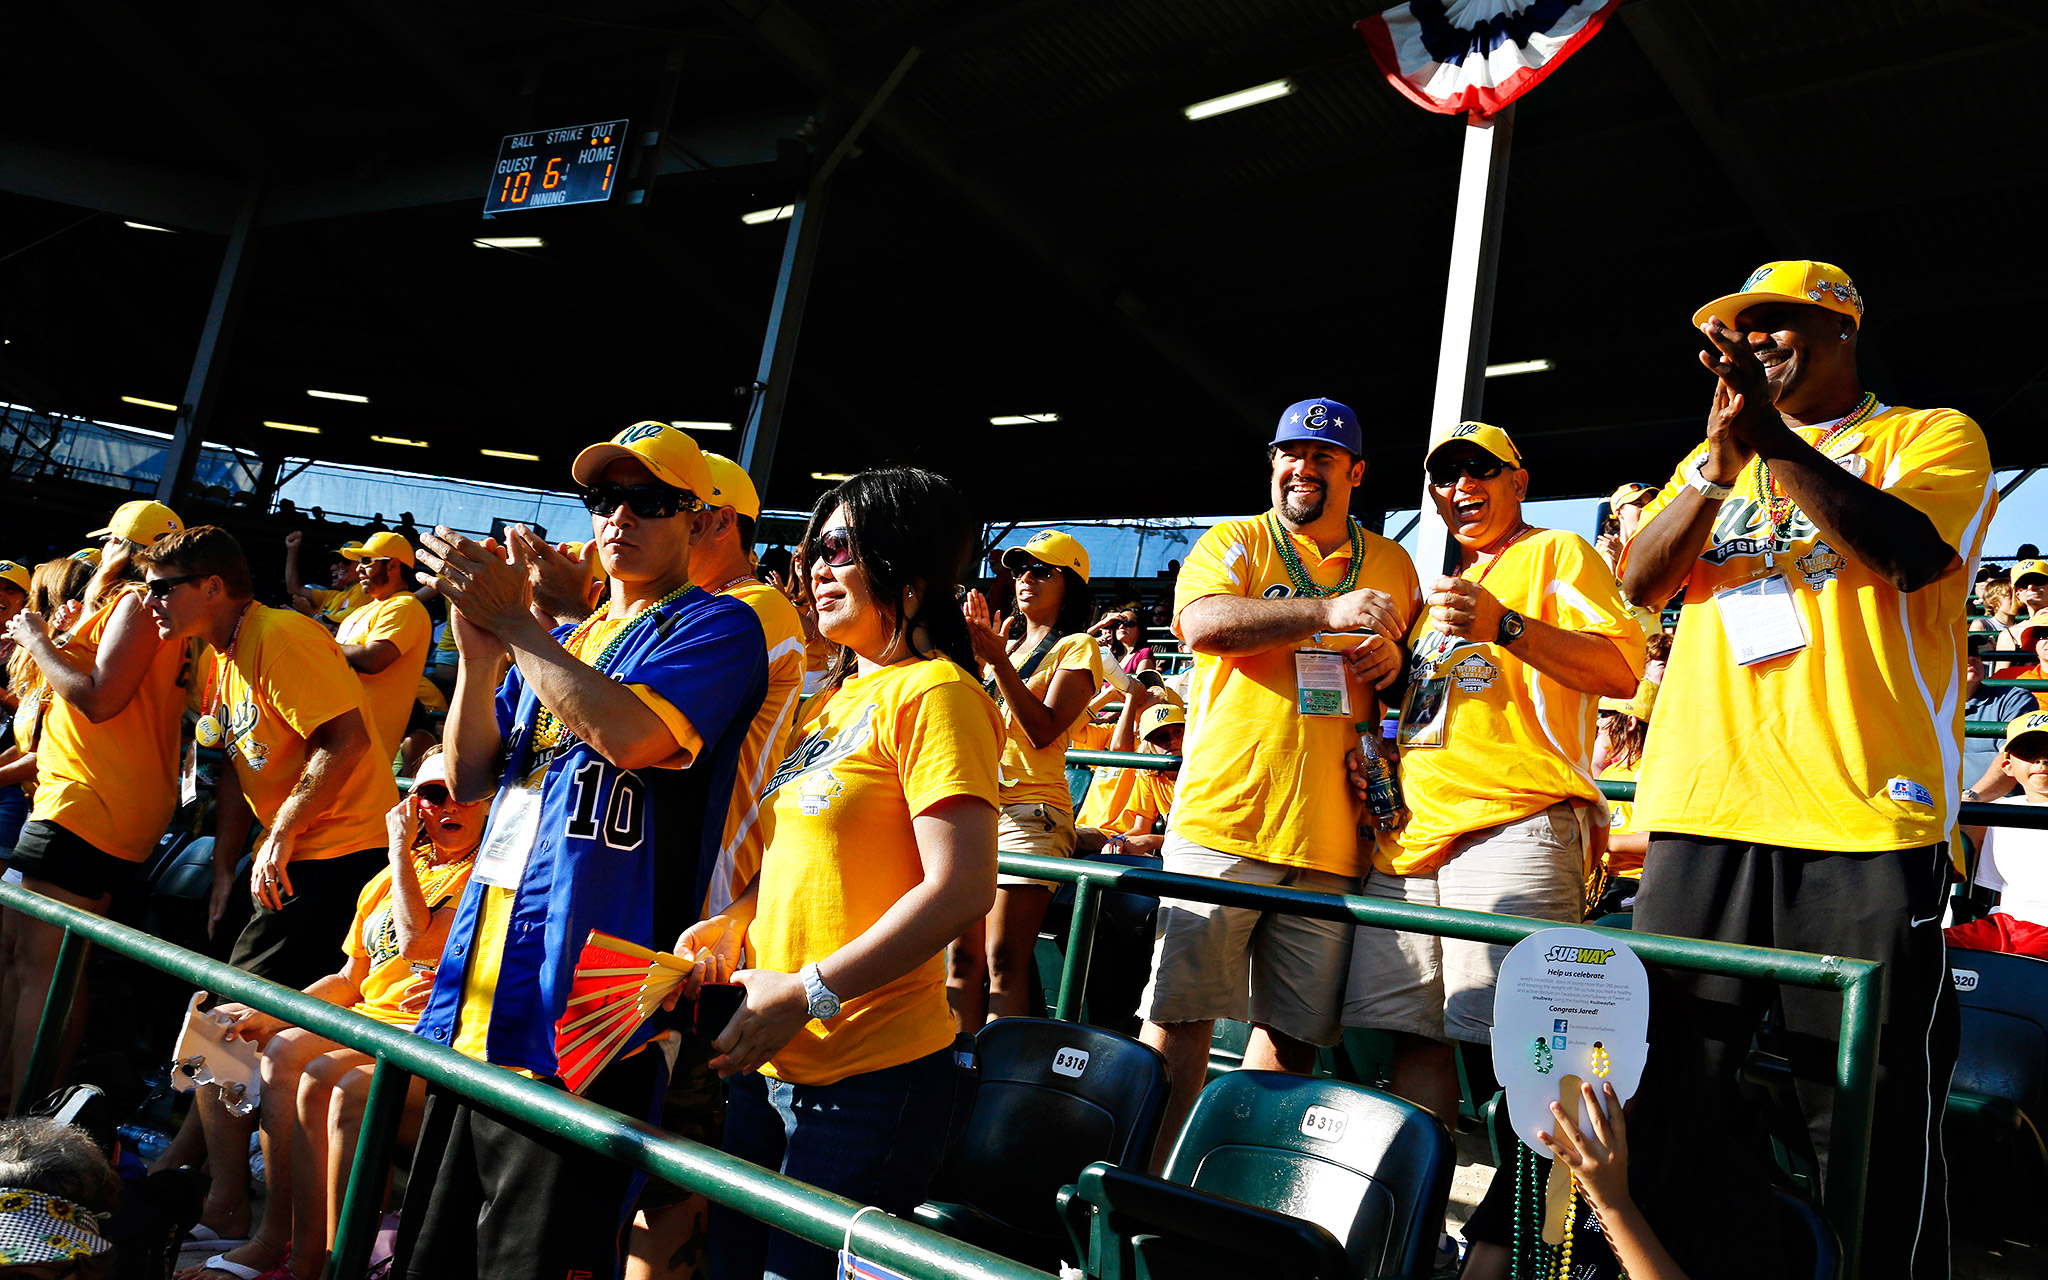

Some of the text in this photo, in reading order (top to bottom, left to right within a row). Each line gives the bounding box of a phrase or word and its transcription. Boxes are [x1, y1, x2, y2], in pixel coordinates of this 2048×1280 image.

[511, 123, 616, 149] BALL STRIKE OUT
[498, 146, 616, 174] GUEST HOME
[500, 157, 613, 203] 10 6 1
[530, 190, 566, 206] INNING
[1303, 404, 1328, 431] E
[1457, 665, 1492, 674] WORLD
[1433, 681, 1445, 690] VIP
[564, 760, 646, 852] 10
[1546, 945, 1615, 964] SUBWAY
[1547, 968, 1564, 977] Help
[1573, 971, 1605, 979] celebrate
[1953, 975, 1975, 987] 320
[1548, 1005, 1599, 1015] Congrats Jared!
